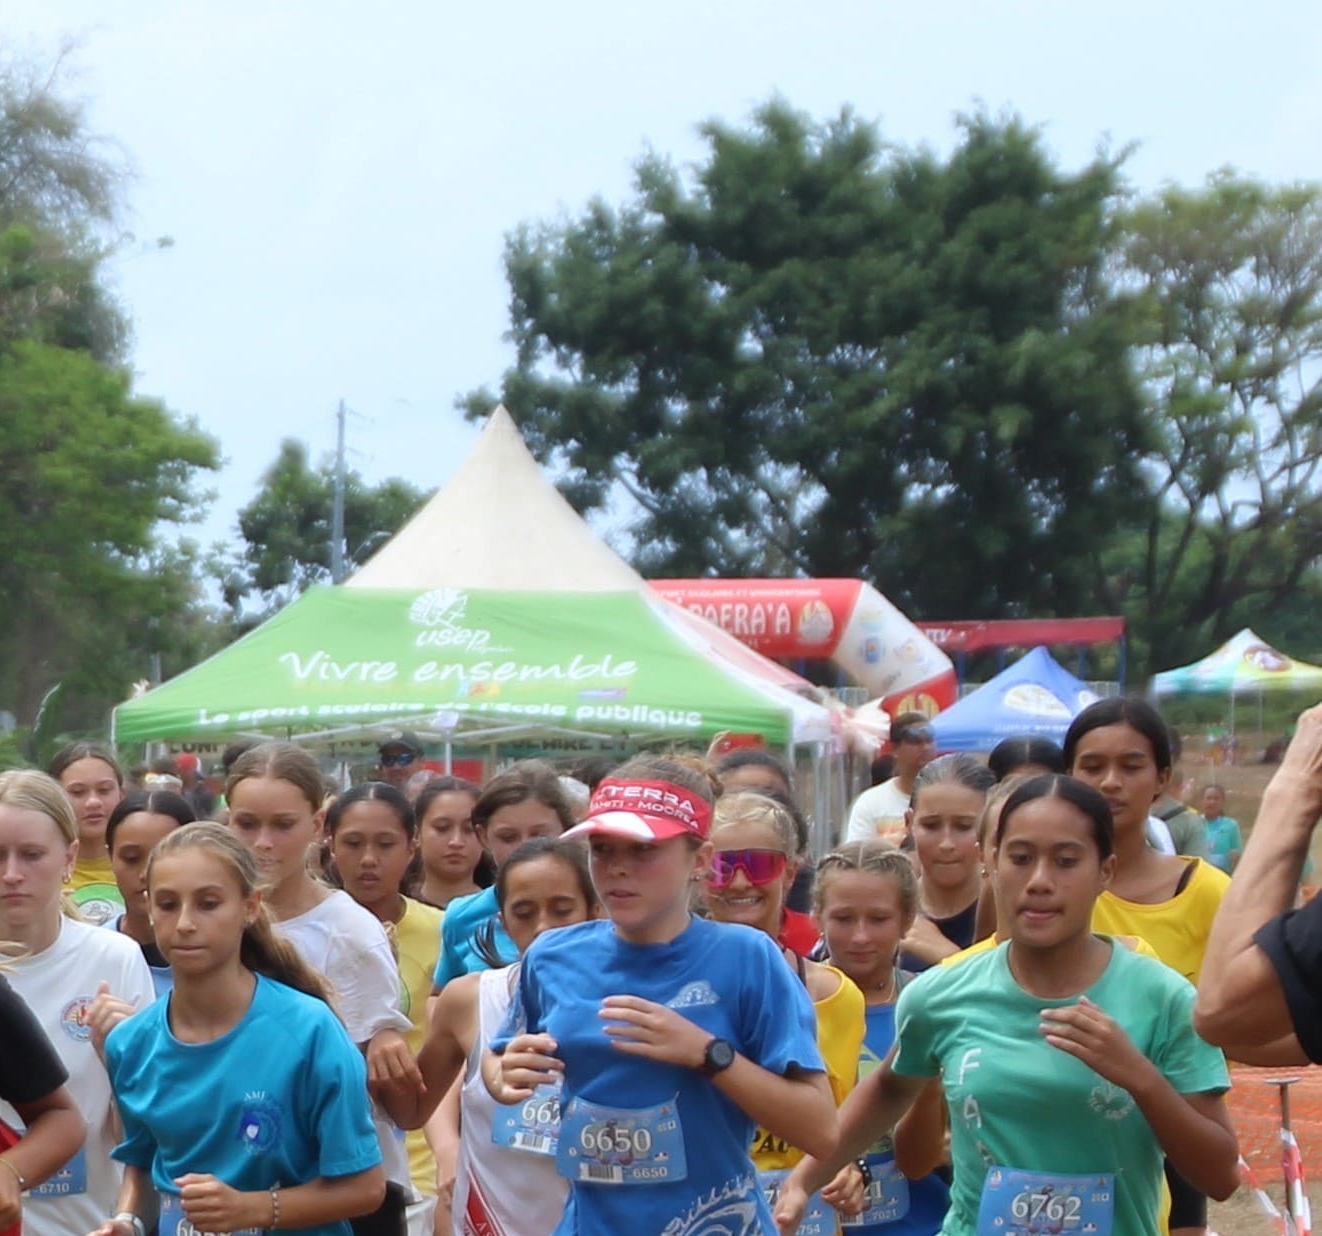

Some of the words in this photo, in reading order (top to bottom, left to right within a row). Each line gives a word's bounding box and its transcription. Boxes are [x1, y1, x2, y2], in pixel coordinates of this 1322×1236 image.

[278, 649, 399, 683] Vivre
[413, 653, 639, 683] ensemble
[575, 703, 704, 728] publique
[637, 799, 700, 830] MOOREA
[579, 1122, 653, 1154] 6650
[38, 1181, 70, 1194] 6710
[1010, 1192, 1083, 1222] 6762
